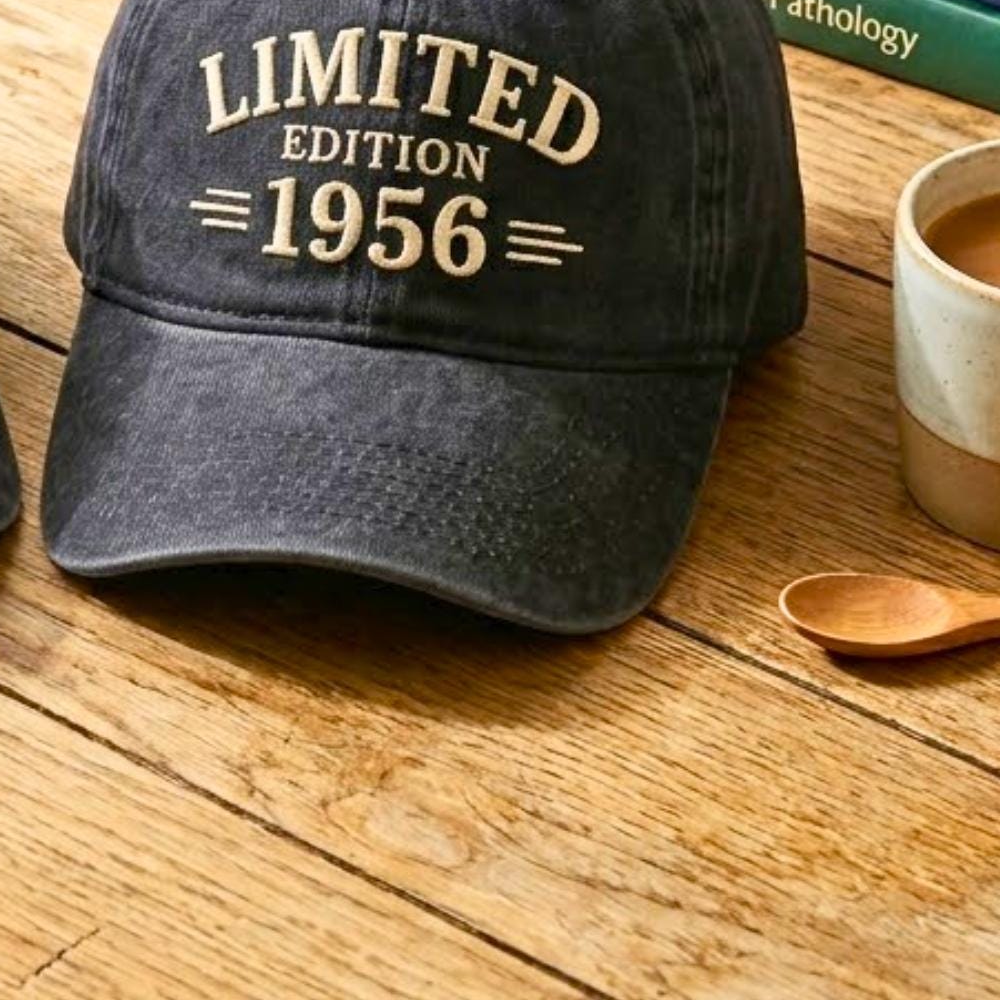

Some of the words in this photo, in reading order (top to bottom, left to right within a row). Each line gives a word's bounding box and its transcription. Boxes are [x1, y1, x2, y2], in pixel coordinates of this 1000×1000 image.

[199, 27, 601, 166] LIMITED
[280, 124, 491, 182] EDITION
[261, 177, 488, 278] 1956
